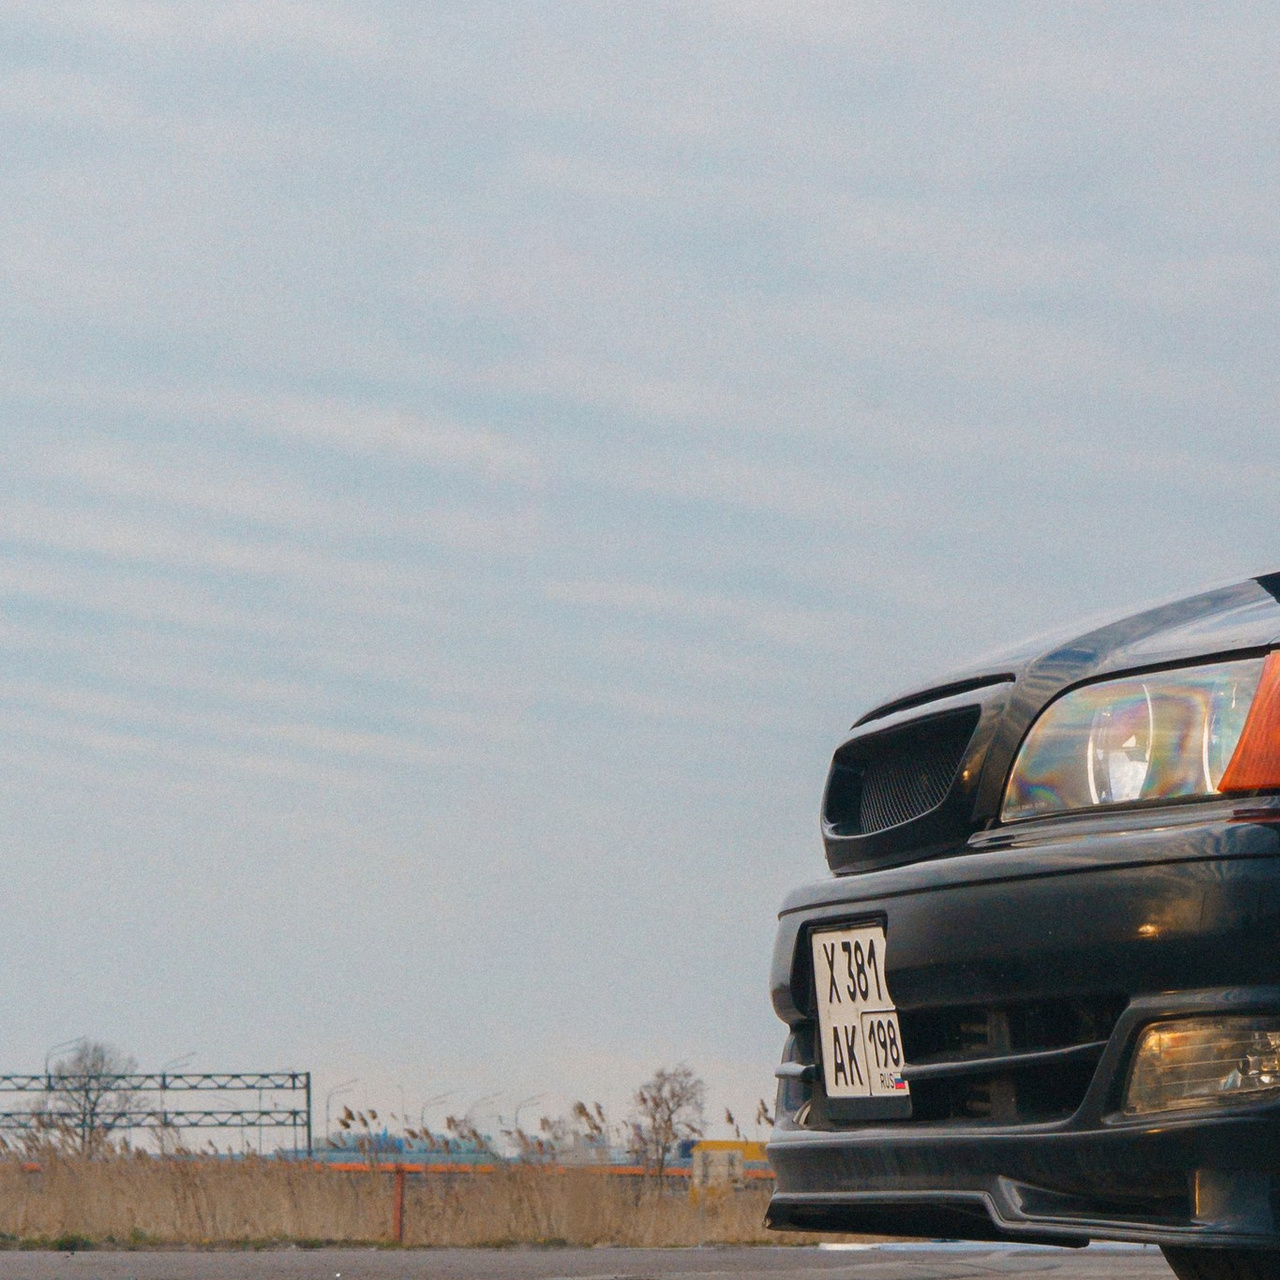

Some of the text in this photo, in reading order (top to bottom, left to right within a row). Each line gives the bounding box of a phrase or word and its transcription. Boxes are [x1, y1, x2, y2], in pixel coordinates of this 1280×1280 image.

[841, 938, 882, 1002] 381
[868, 1019, 901, 1068] 198
[880, 1072, 895, 1090] RUS
